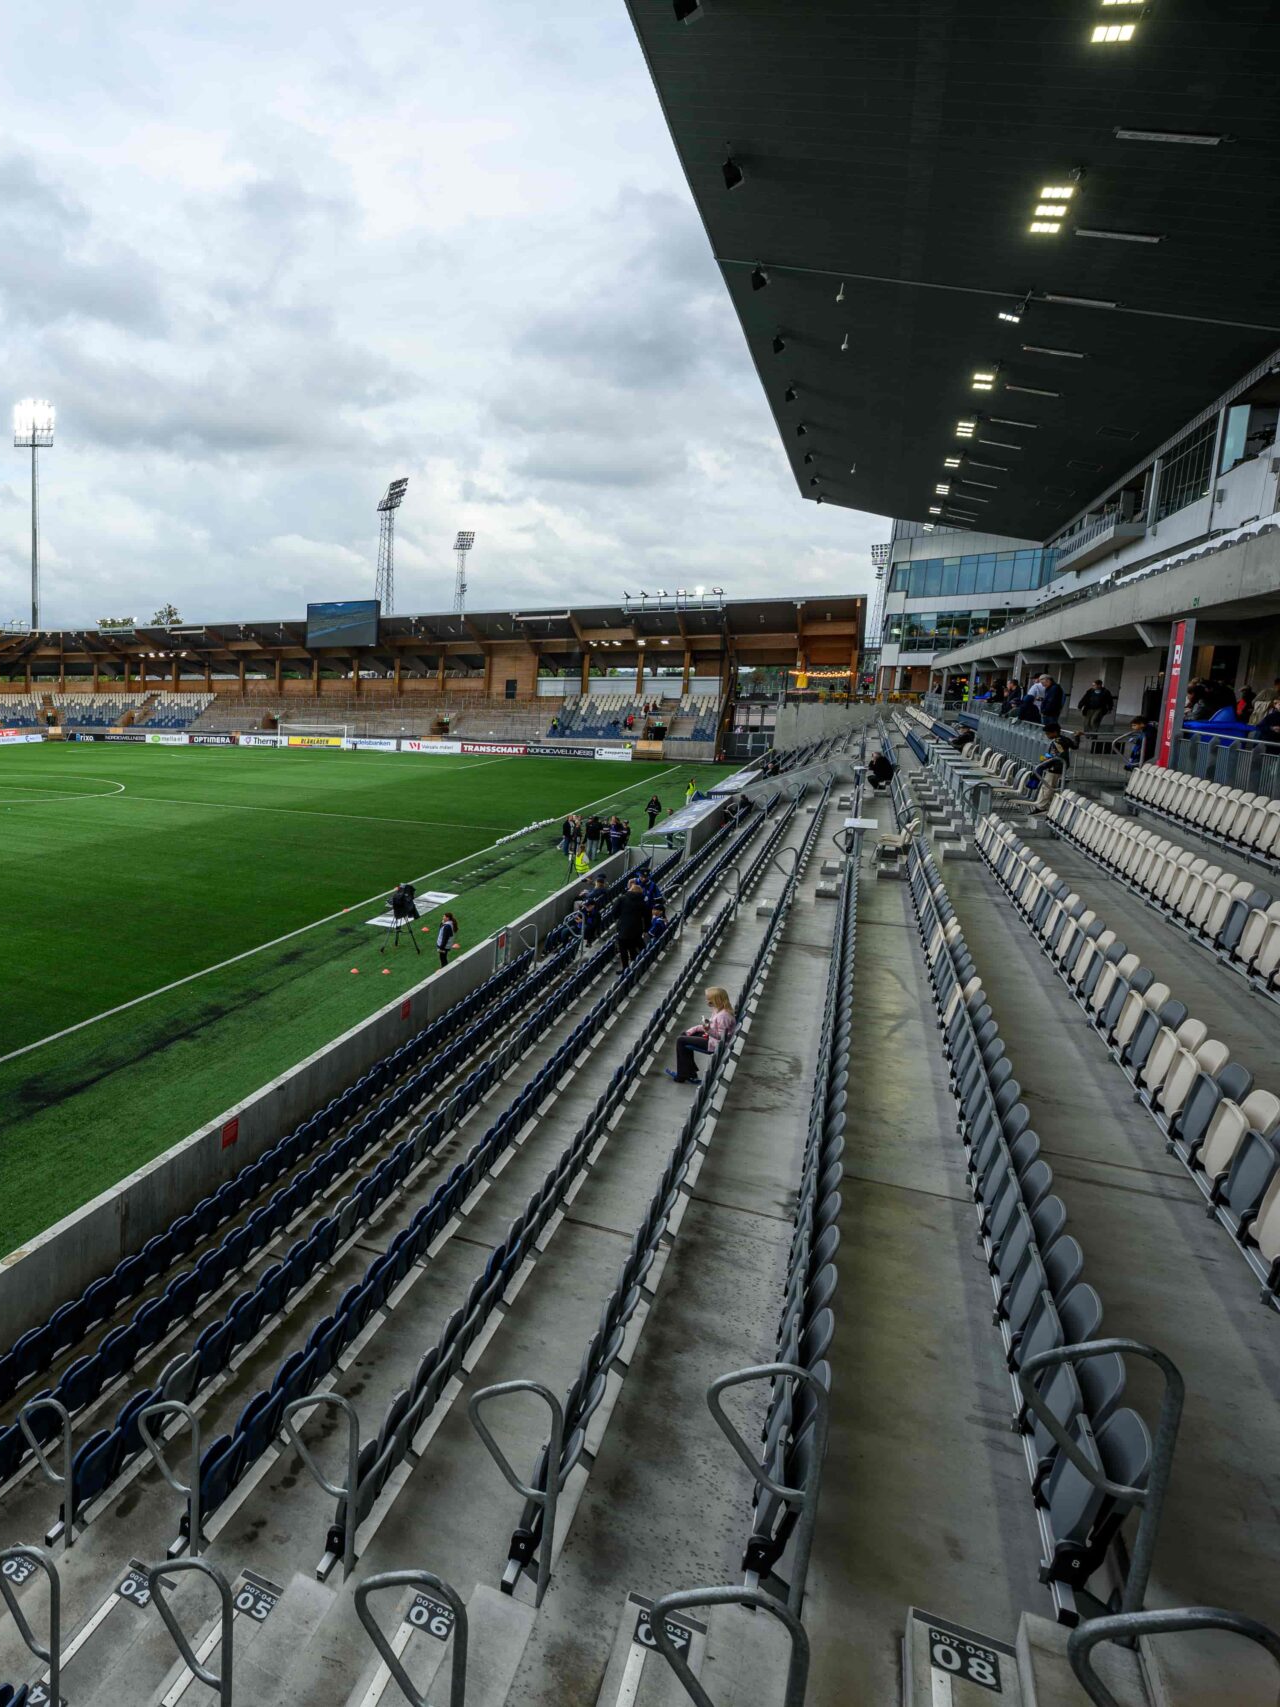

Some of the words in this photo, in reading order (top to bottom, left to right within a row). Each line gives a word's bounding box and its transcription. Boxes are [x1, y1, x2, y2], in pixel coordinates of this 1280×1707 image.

[193, 736, 231, 744] OPTIMERA
[346, 738, 391, 746] Handelsbanken
[463, 744, 525, 755] TRANSSCHAKT
[15, 1556, 36, 1572] 07-043
[758, 1550, 765, 1559] 7
[1072, 1559, 1080, 1568] 8
[2, 1560, 29, 1582] 03
[129, 1573, 149, 1587] 007-0
[120, 1579, 151, 1605] 04
[244, 1584, 277, 1605] 007-043
[236, 1592, 272, 1619] 05
[415, 1596, 455, 1620] 007-043
[408, 1605, 451, 1636] 06
[640, 1612, 689, 1639] 0043
[931, 1632, 995, 1662] 007-043
[933, 1643, 997, 1685] 08
